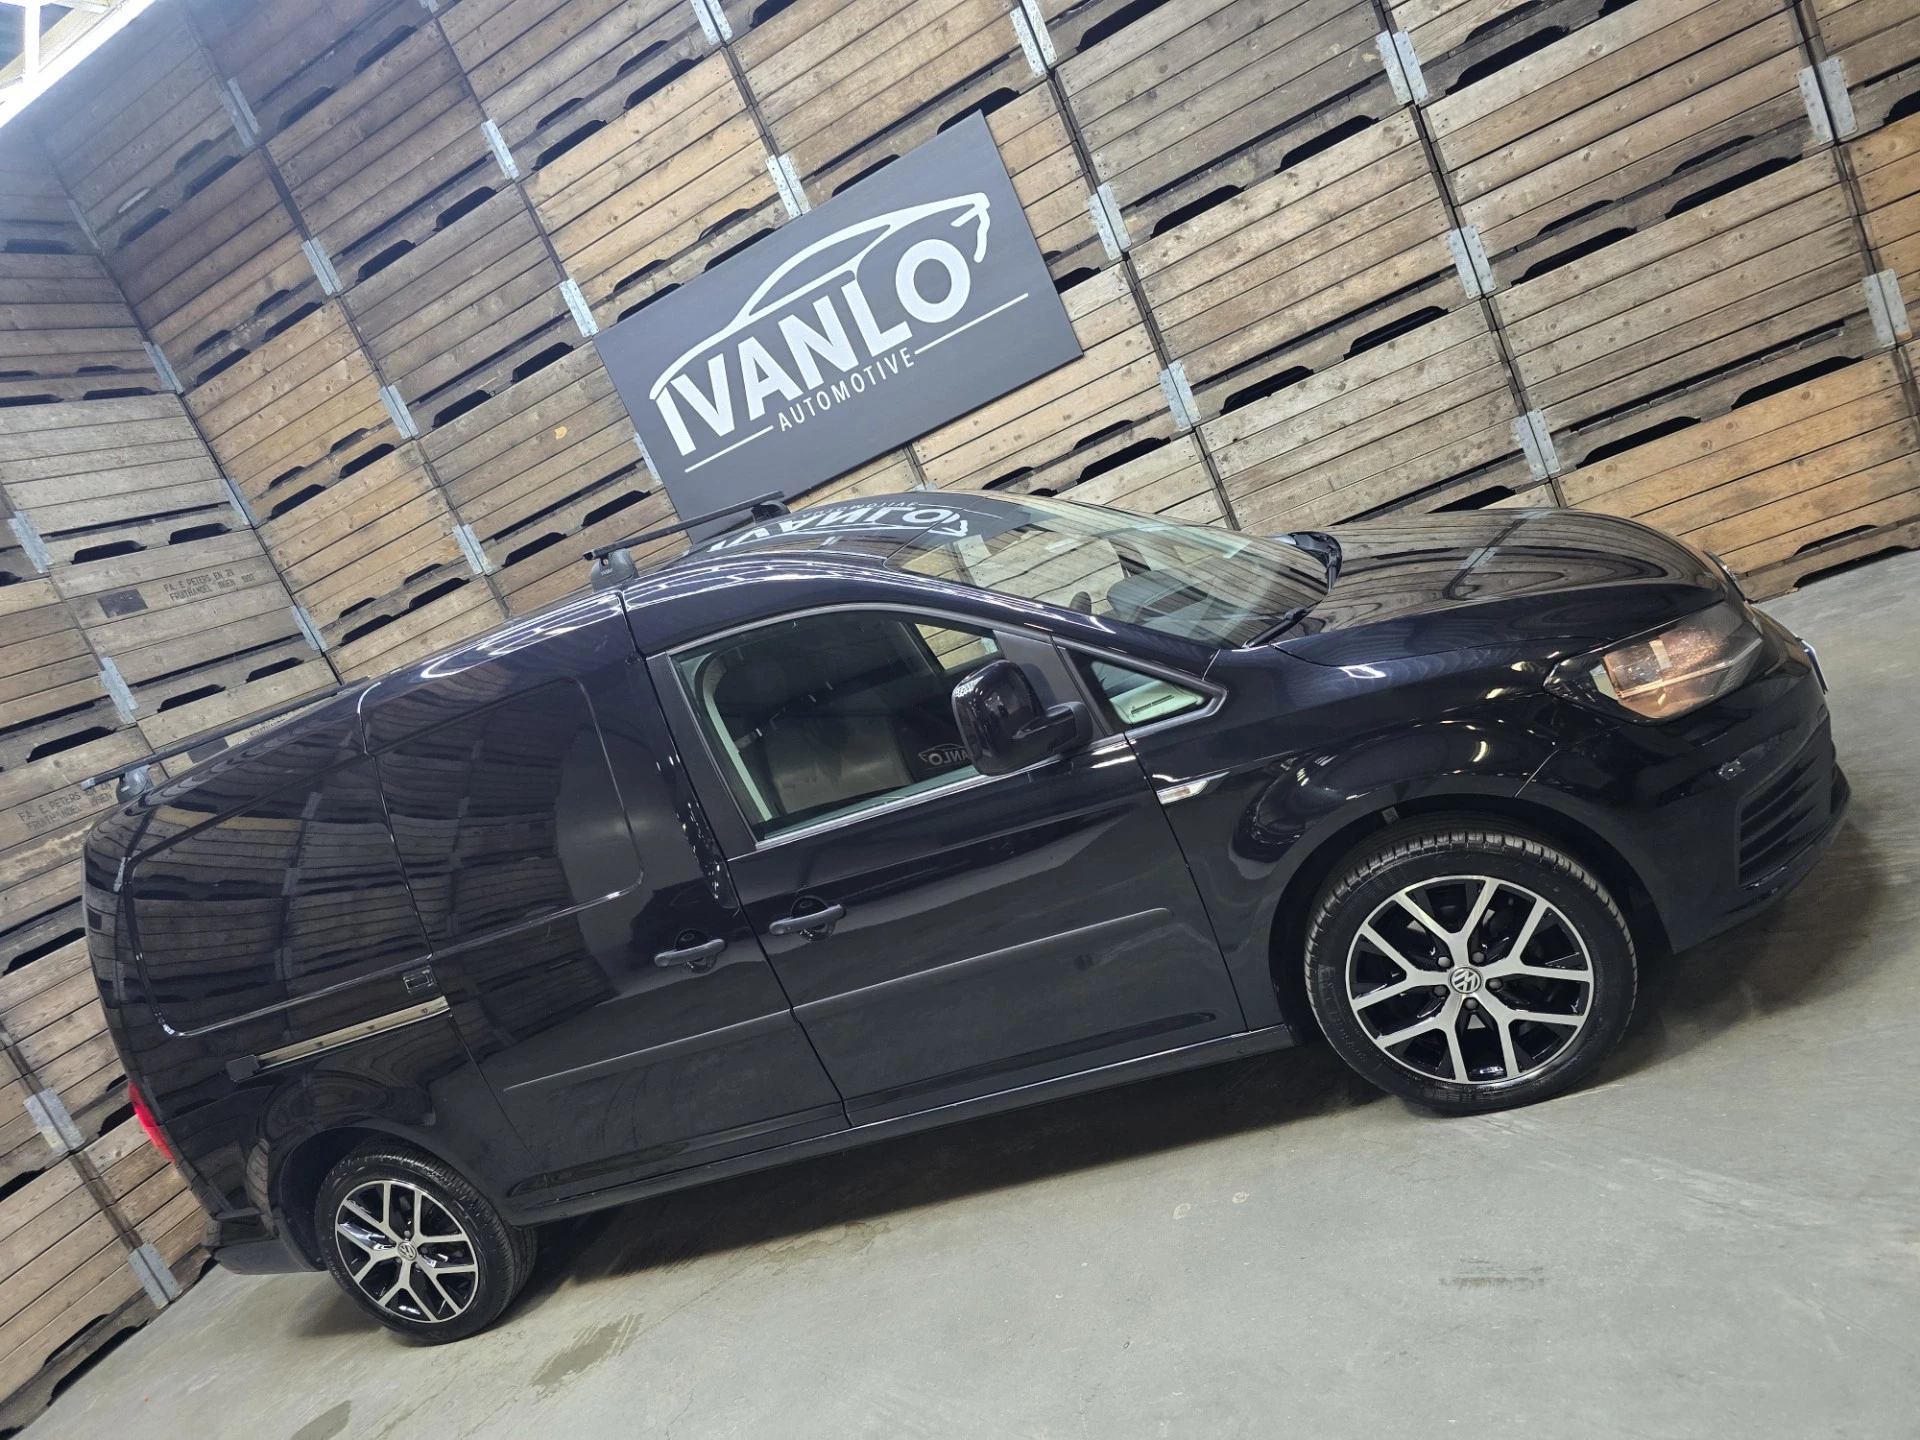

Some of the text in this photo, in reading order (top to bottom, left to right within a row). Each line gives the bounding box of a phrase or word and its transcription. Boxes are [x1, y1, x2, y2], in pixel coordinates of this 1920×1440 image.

[655, 238, 971, 457] IVANLO
[778, 347, 915, 432] AUTOMOTIVE
[186, 574, 211, 586] PETERS
[49, 791, 82, 810] PETERS
